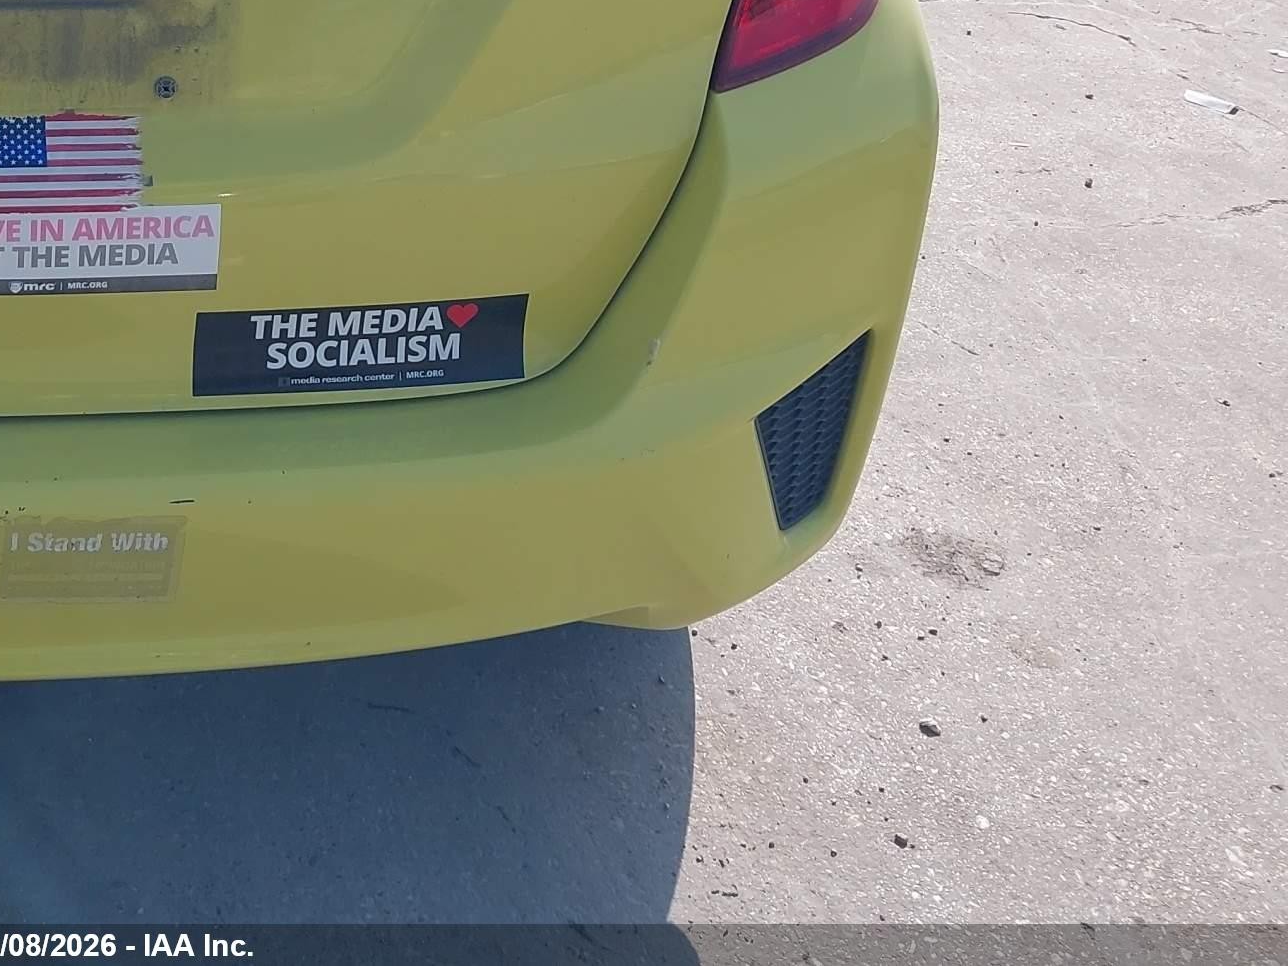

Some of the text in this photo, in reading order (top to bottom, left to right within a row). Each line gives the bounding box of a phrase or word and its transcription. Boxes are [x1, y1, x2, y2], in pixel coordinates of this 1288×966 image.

[30, 218, 63, 241] IN
[71, 215, 215, 241] AMERICA
[12, 245, 69, 268] THE
[78, 242, 178, 267] MEDIA
[23, 281, 108, 291] mrc MRC.ORG
[250, 306, 444, 340] THE MEDIA
[266, 333, 461, 369] SOCIALISM
[291, 369, 445, 385] media research center MRC.ORG
[10, 532, 169, 552] I Stand With
